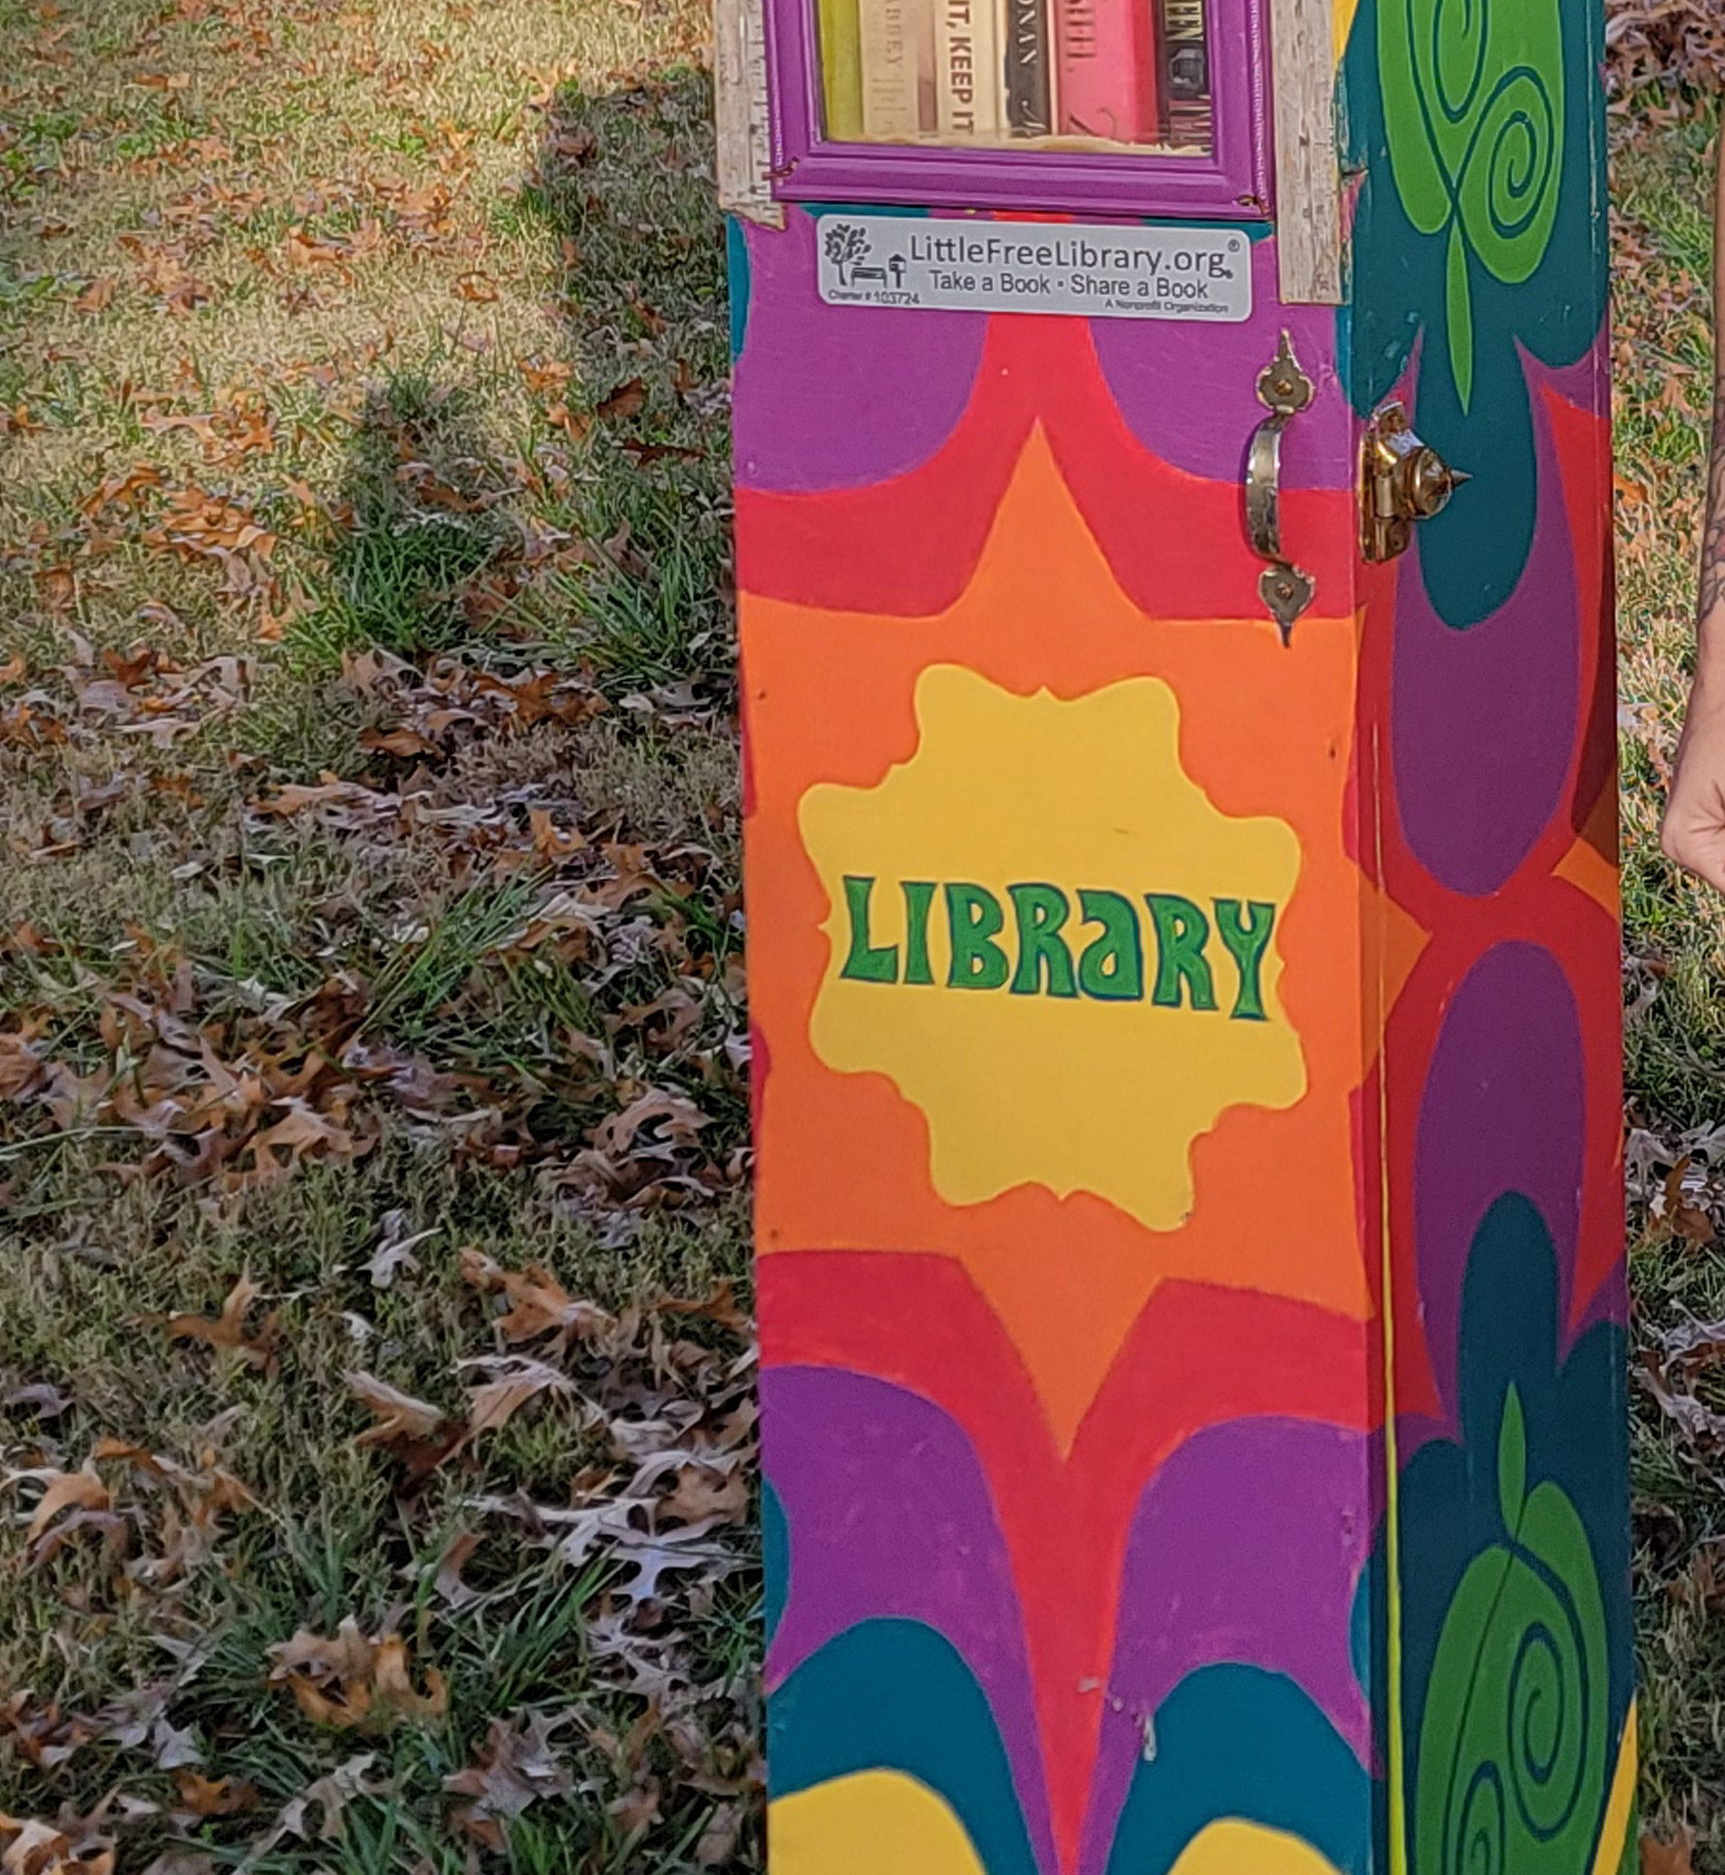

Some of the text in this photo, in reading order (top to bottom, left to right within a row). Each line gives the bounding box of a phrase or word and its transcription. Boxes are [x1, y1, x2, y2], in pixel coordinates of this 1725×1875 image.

[950, 34, 972, 104] KEEP
[952, 109, 974, 135] IT
[929, 269, 1209, 300] Take a Book Share a Book
